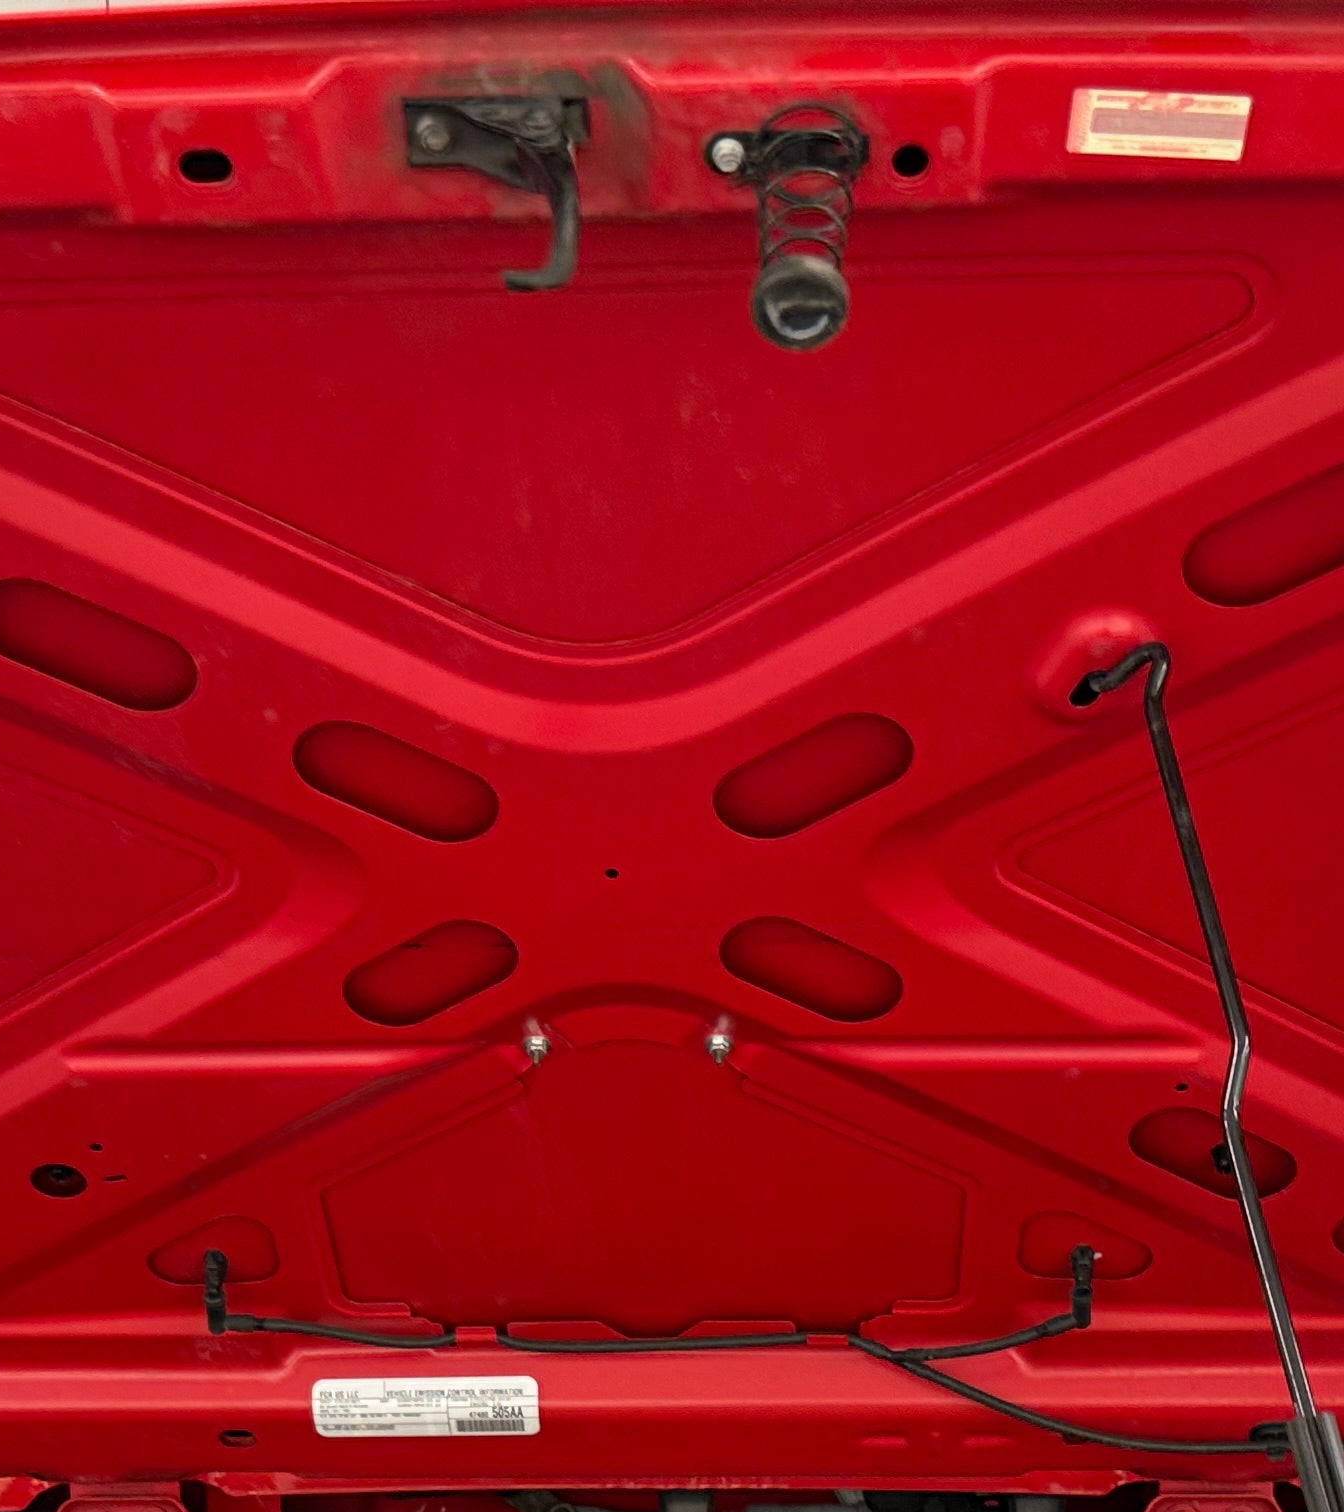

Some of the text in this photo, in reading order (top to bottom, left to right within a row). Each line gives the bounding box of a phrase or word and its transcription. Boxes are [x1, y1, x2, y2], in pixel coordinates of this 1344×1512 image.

[386, 1389, 413, 1399] VEHICLE
[447, 1388, 476, 1398] CONTROL
[478, 1387, 523, 1397] INFORMATION
[492, 1406, 525, 1418] 505AA
